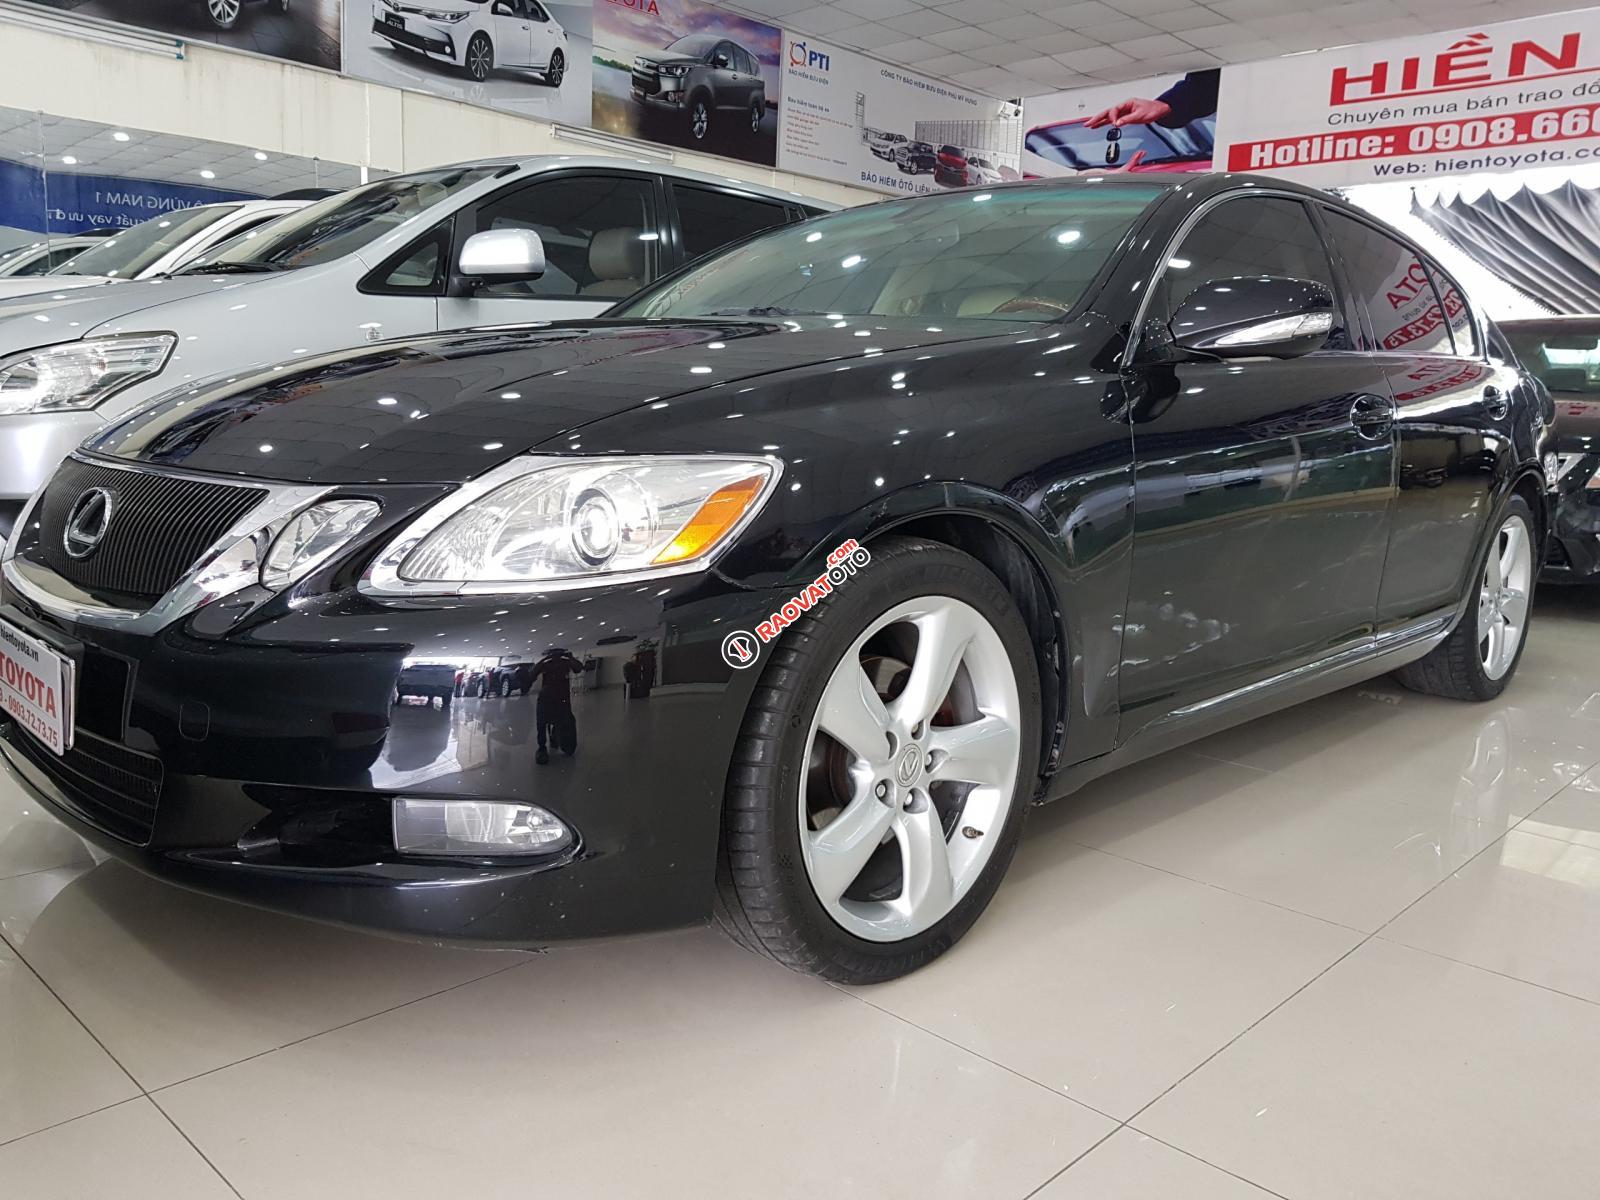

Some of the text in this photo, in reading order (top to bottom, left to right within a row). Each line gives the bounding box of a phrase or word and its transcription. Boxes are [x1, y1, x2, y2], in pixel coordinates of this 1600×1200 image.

[808, 50, 830, 72] PTI
[1329, 32, 1581, 107] HIỀN
[896, 74, 903, 82] TY
[1327, 107, 1405, 126] Chuyên
[1413, 101, 1459, 117] mua
[1466, 95, 1509, 111] bán
[1518, 89, 1563, 104] trao
[1250, 133, 1396, 169] Hotline:
[861, 171, 877, 183] BẢO
[898, 178, 913, 192] ÔTÔ
[1373, 161, 1427, 177] Web:
[8, 694, 58, 748] 0903.72.73.75
